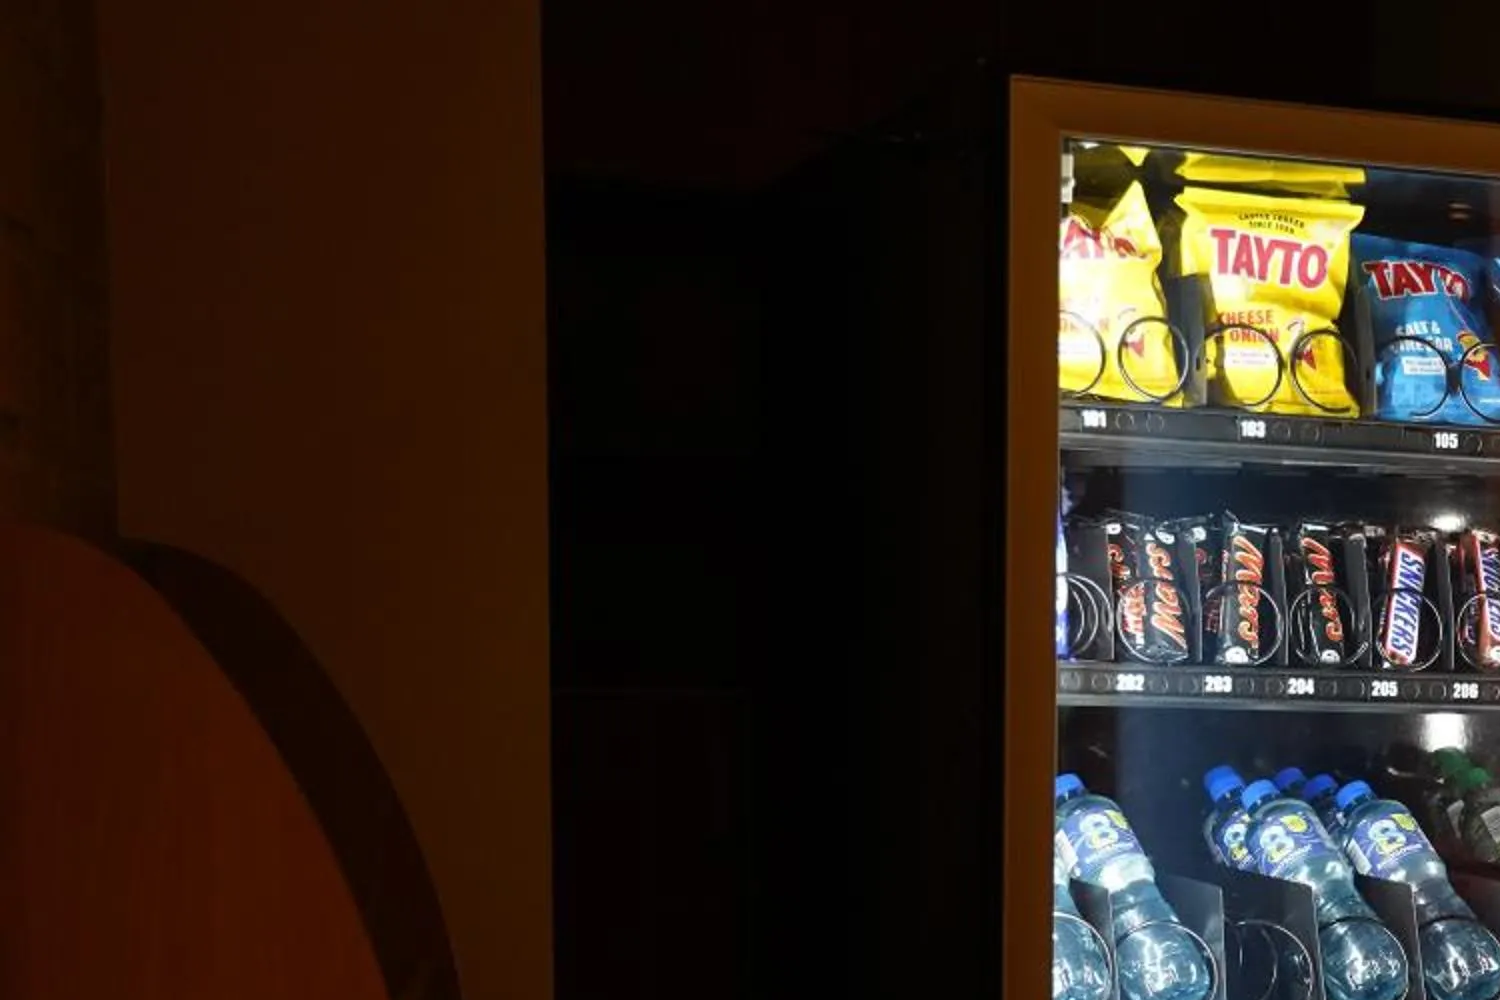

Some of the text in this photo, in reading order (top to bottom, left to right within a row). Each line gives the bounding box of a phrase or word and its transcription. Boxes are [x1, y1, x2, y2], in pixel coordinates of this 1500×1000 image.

[1210, 228, 1328, 289] TAYTO
[1240, 419, 1266, 438] 103
[1434, 432, 1459, 449] 105
[1391, 552, 1424, 657] SNICKERS
[1287, 677, 1315, 695] 204
[1371, 680, 1399, 697] 205
[1452, 682, 1479, 699] 206
